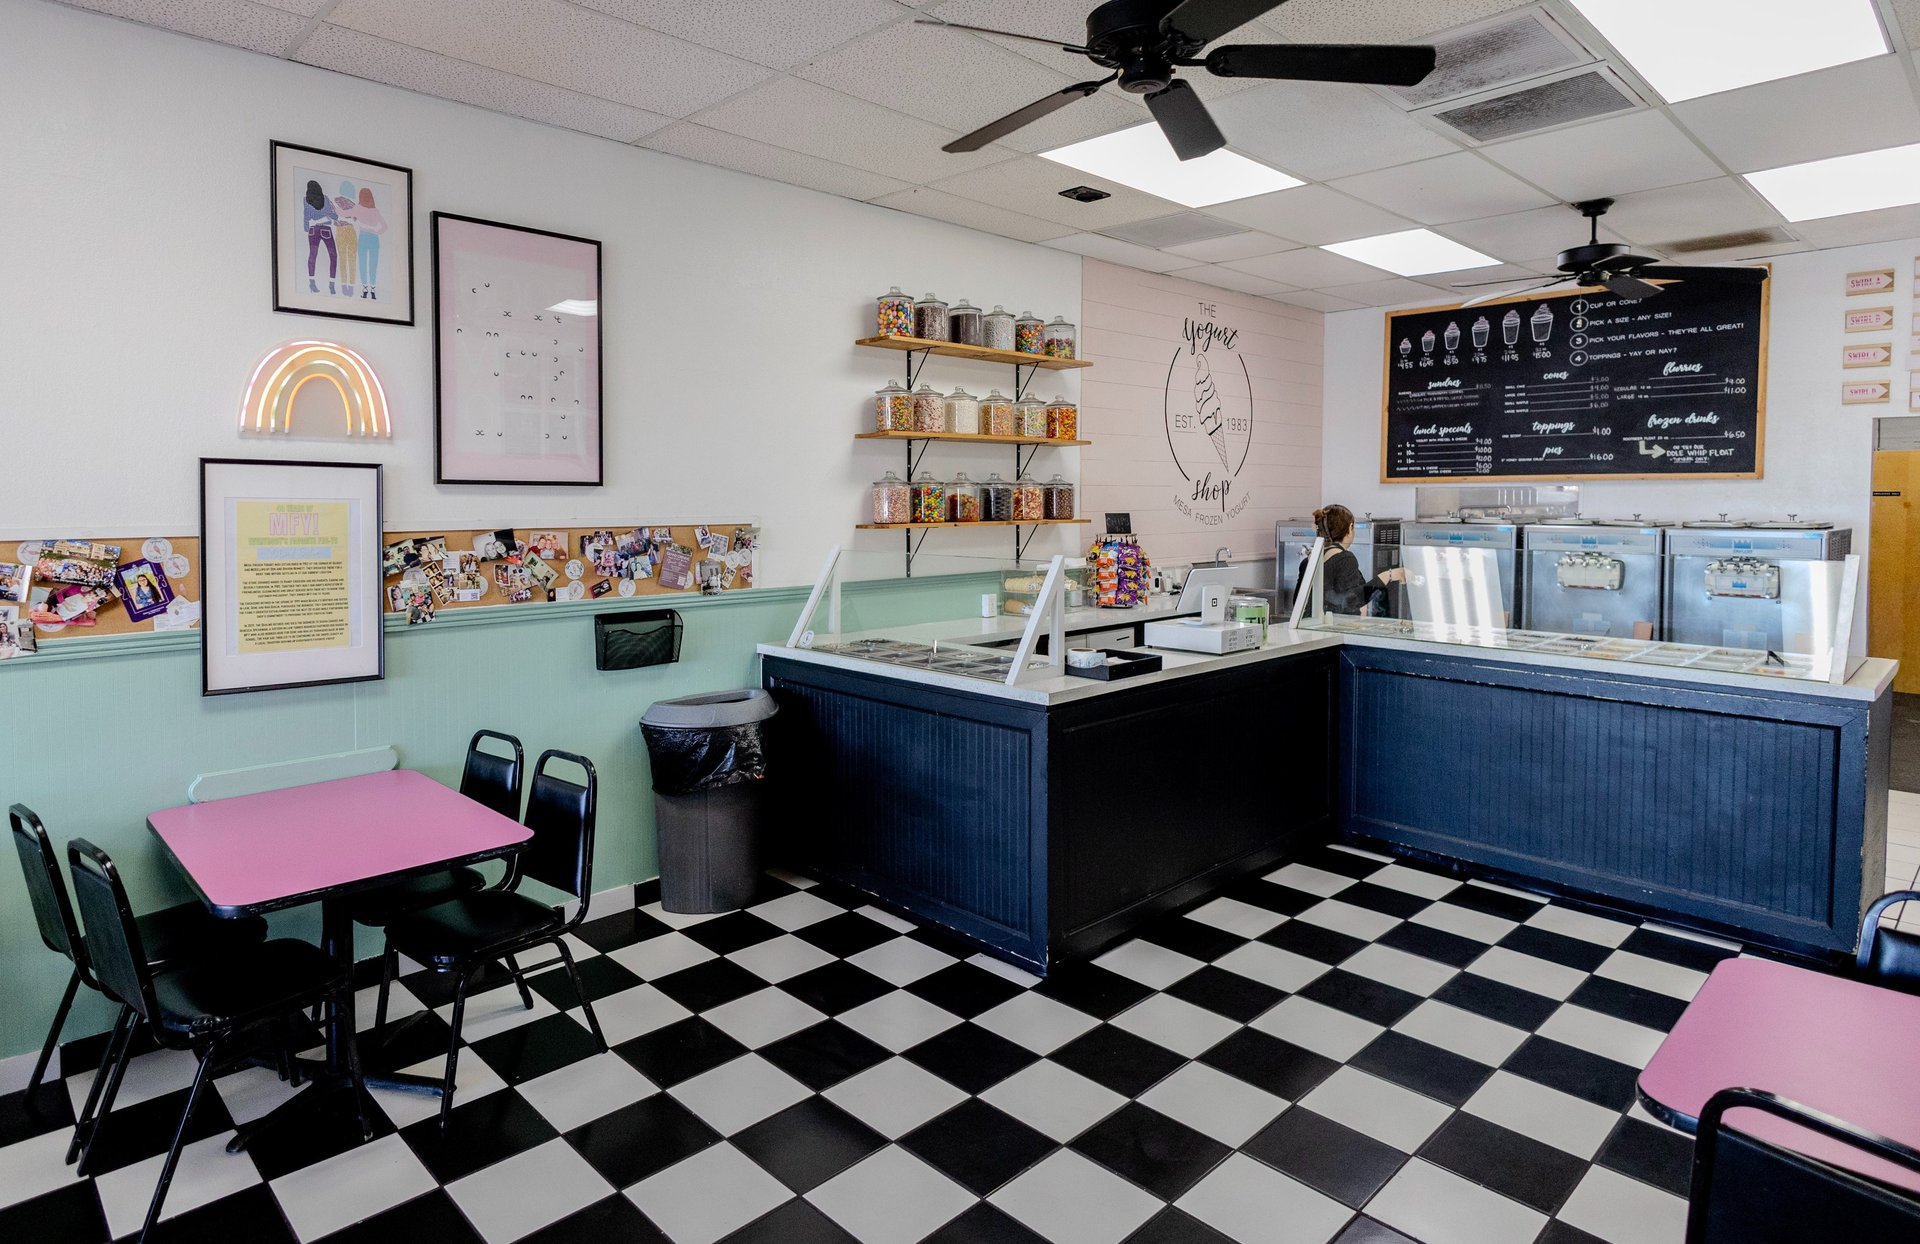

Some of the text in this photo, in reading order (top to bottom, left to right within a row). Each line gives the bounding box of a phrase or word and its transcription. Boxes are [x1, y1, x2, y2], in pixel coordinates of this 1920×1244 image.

[1198, 302, 1217, 318] THE
[1182, 316, 1239, 356] Yogurt
[1628, 331, 1659, 339] FLAVORS
[1668, 327, 1698, 336] THEY'RE
[1716, 322, 1744, 330] GREAT!
[1589, 352, 1622, 360] TOPPINGS
[1543, 371, 1569, 380] cones
[1662, 361, 1703, 376] flurries
[1428, 377, 1462, 389] sundaes
[1175, 414, 1196, 430] EST.
[1226, 417, 1248, 432] 1983
[1532, 421, 1576, 434] toppings
[1647, 412, 1720, 429] frozen drinks
[1414, 422, 1472, 437] lunch specials
[1542, 447, 1564, 458] pies
[1192, 472, 1232, 512] shop
[1172, 492, 1252, 526] MESA FROZEN YOGURT
[269, 512, 320, 536] MFY!
